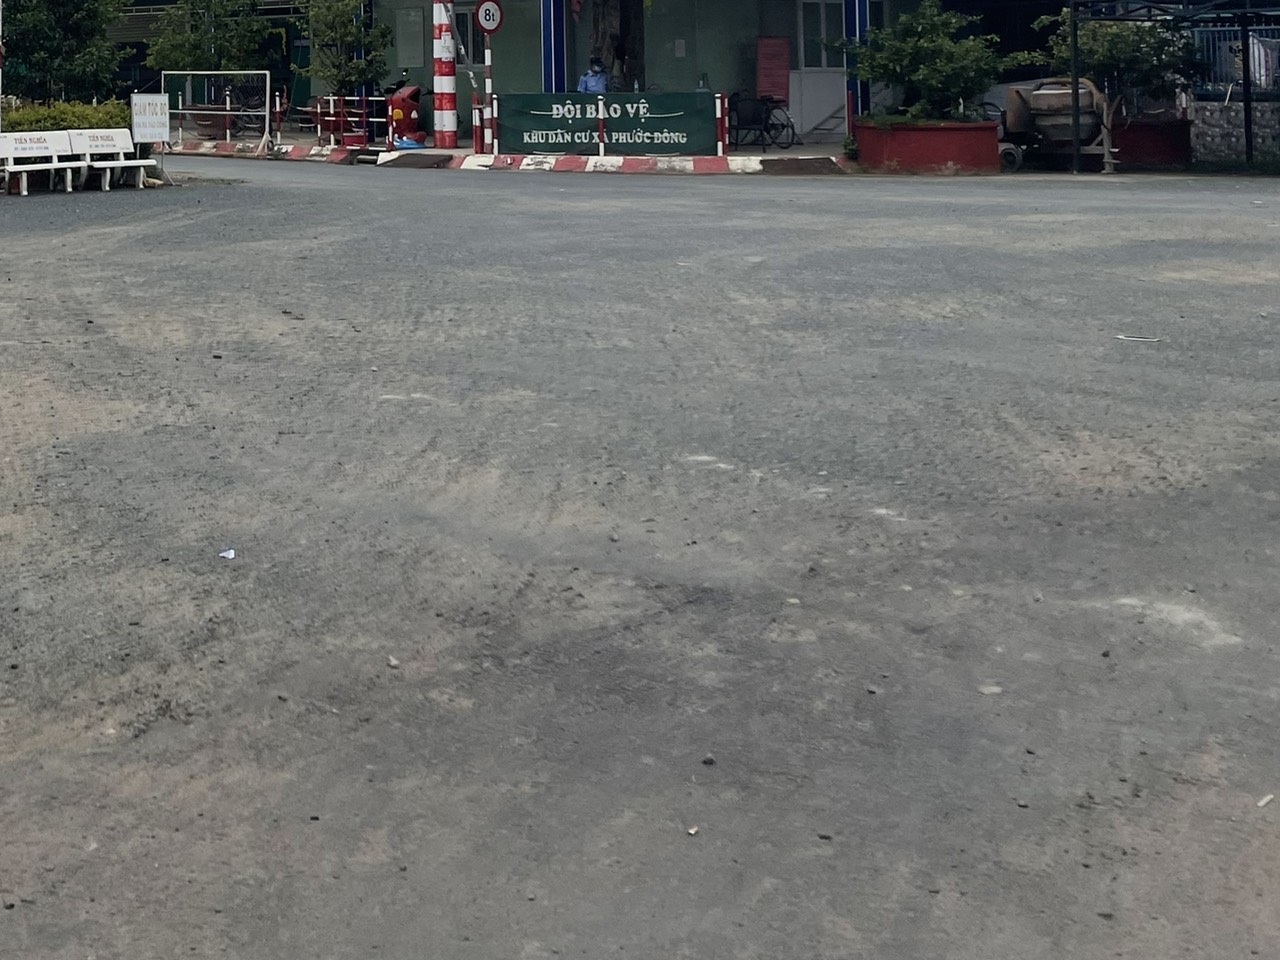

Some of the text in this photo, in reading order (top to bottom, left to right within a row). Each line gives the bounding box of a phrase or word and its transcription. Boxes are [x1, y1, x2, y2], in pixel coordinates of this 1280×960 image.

[552, 100, 582, 124] ĐỘI
[625, 99, 650, 123] VỆ
[523, 131, 547, 143] KHU
[548, 129, 572, 143] DÂN
[574, 129, 591, 143] CƯ
[611, 128, 653, 143] PHƯỚC
[654, 129, 688, 143] ĐÔNG
